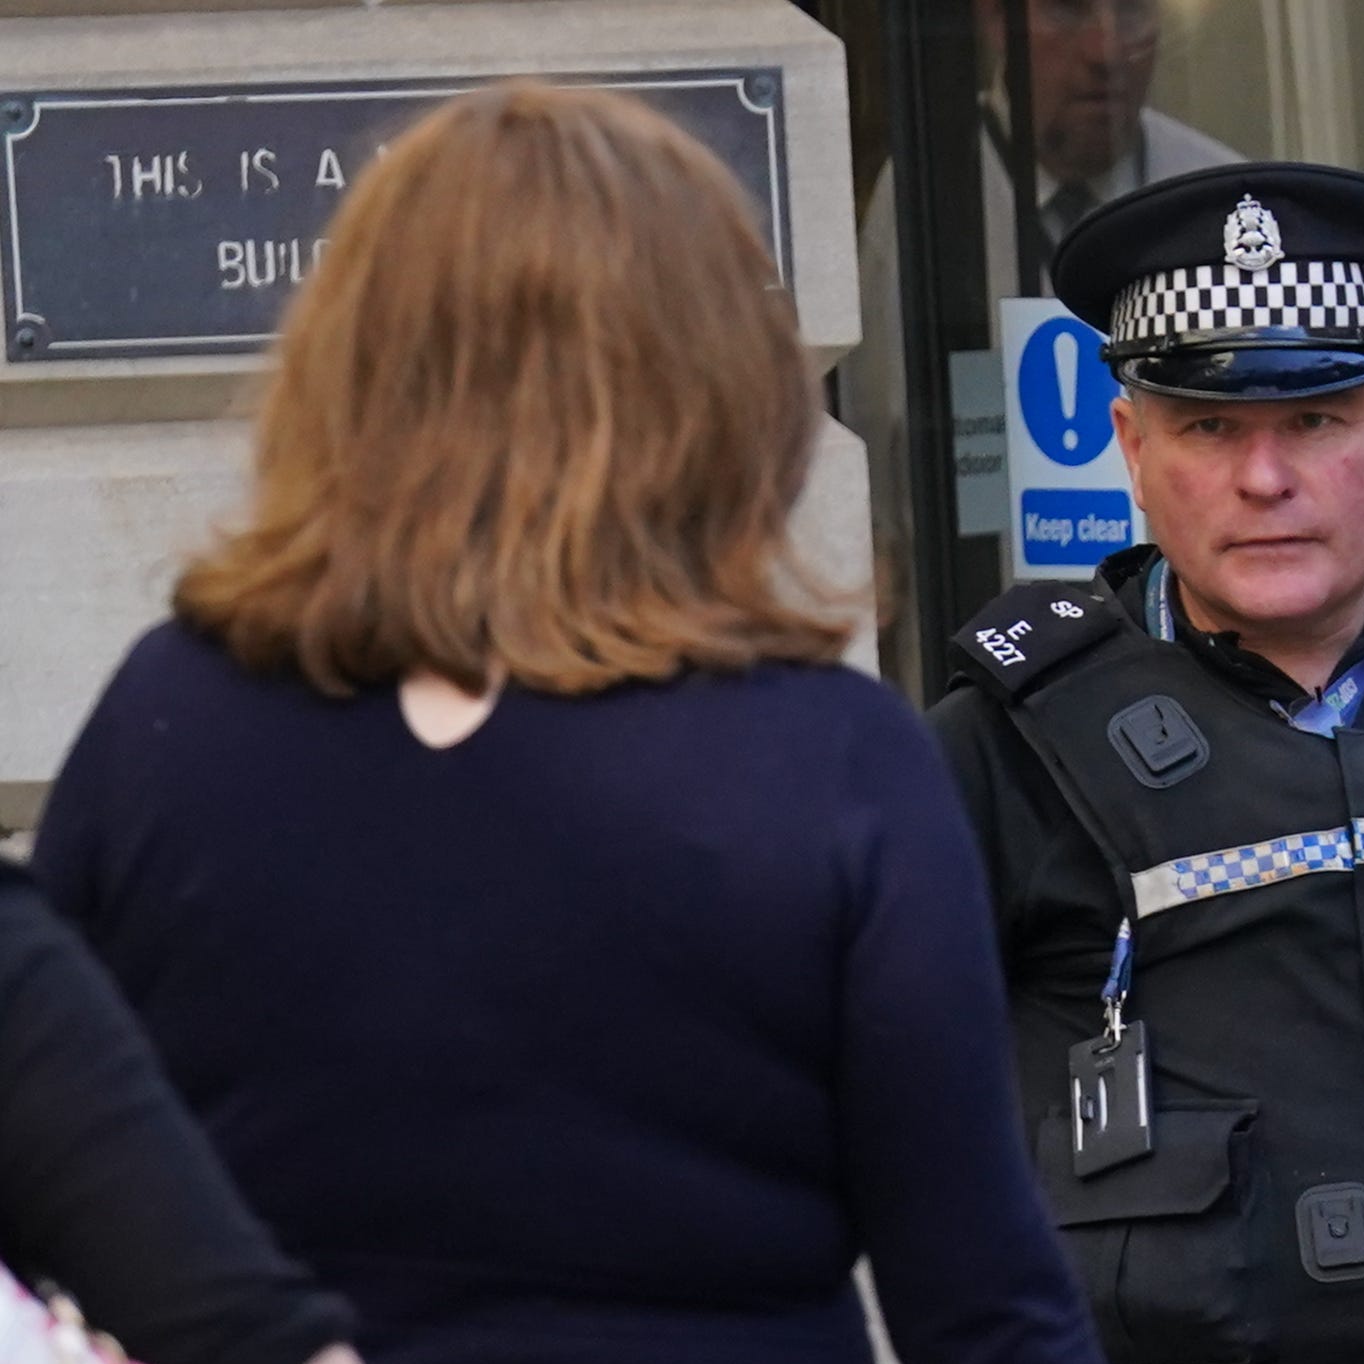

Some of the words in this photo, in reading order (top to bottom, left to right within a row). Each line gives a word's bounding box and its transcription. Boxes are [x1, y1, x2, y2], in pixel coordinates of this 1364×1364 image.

[105, 150, 203, 199] THIS
[240, 148, 280, 193] IS
[314, 148, 346, 190] A
[1025, 513, 1073, 547] Keep
[1077, 513, 1129, 542] clear
[1050, 600, 1085, 620] SP
[975, 627, 1027, 667] 4227
[1006, 619, 1033, 641] E
